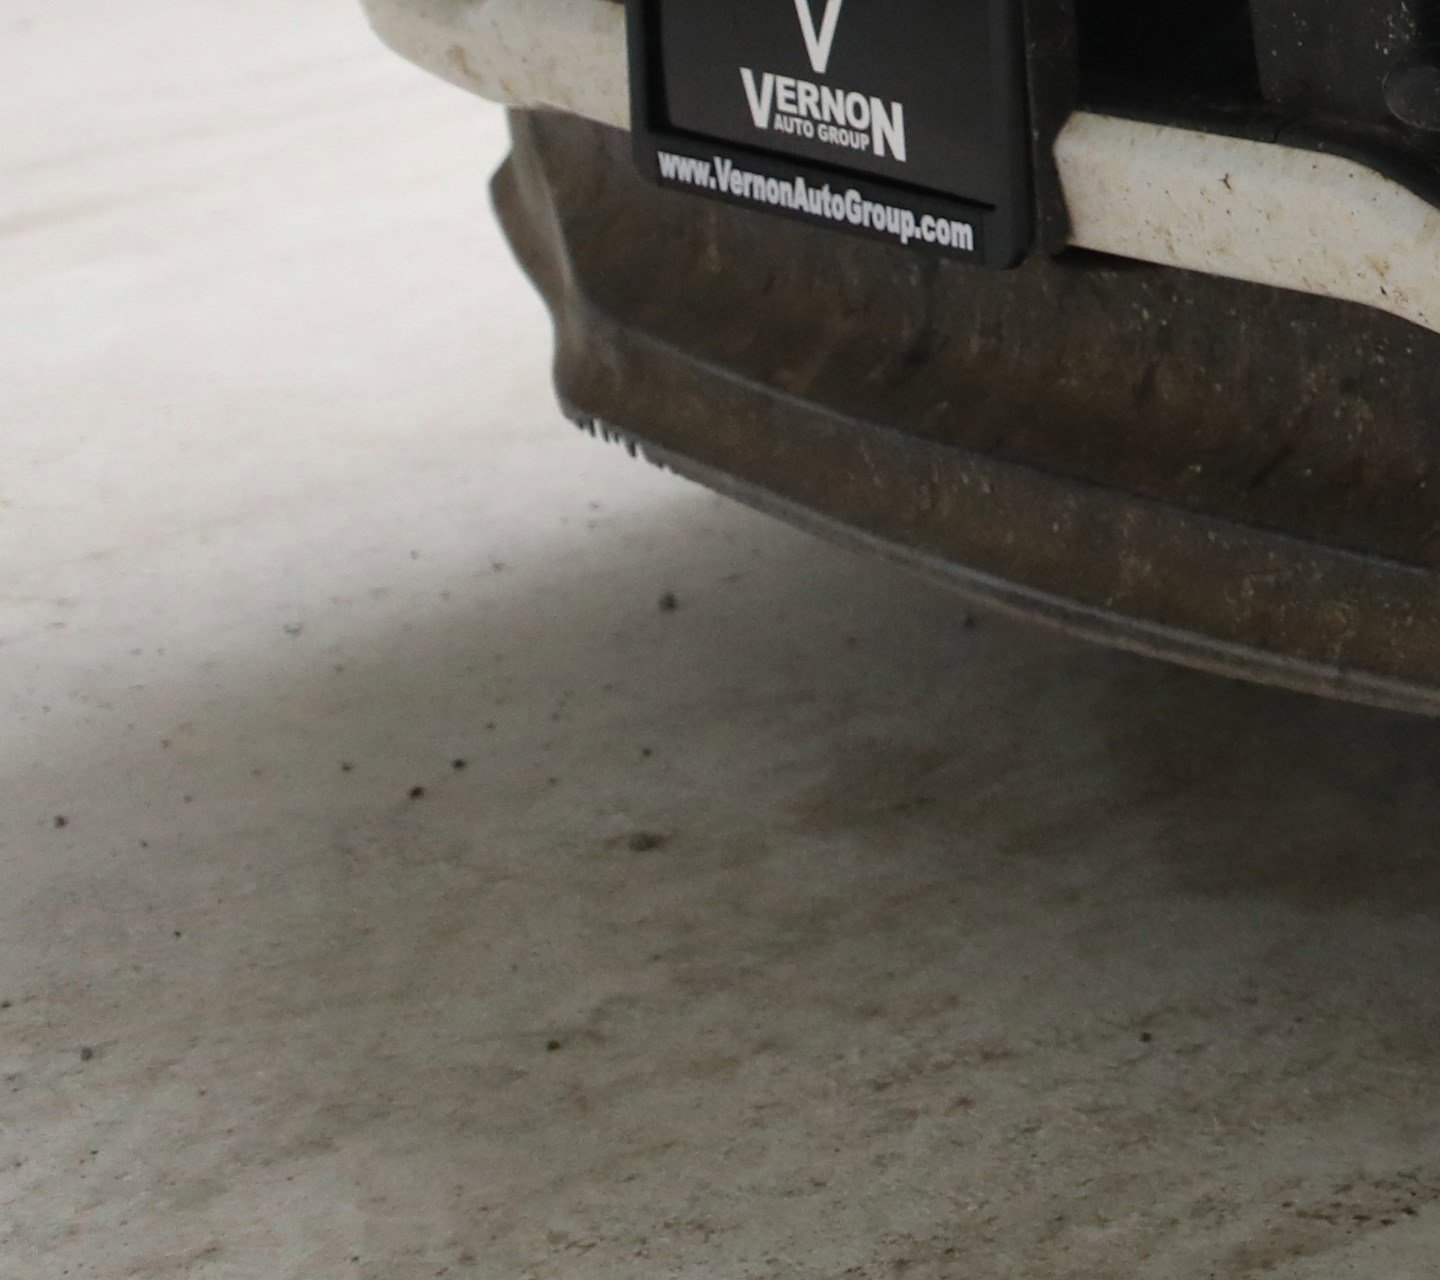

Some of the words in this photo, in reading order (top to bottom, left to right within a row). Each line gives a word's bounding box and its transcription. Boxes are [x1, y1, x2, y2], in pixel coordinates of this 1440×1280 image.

[740, 66, 906, 162] VERNON
[774, 113, 815, 139] AUTO
[817, 123, 870, 150] GROUP
[657, 150, 974, 252] www.VernonAutoGroup.com
